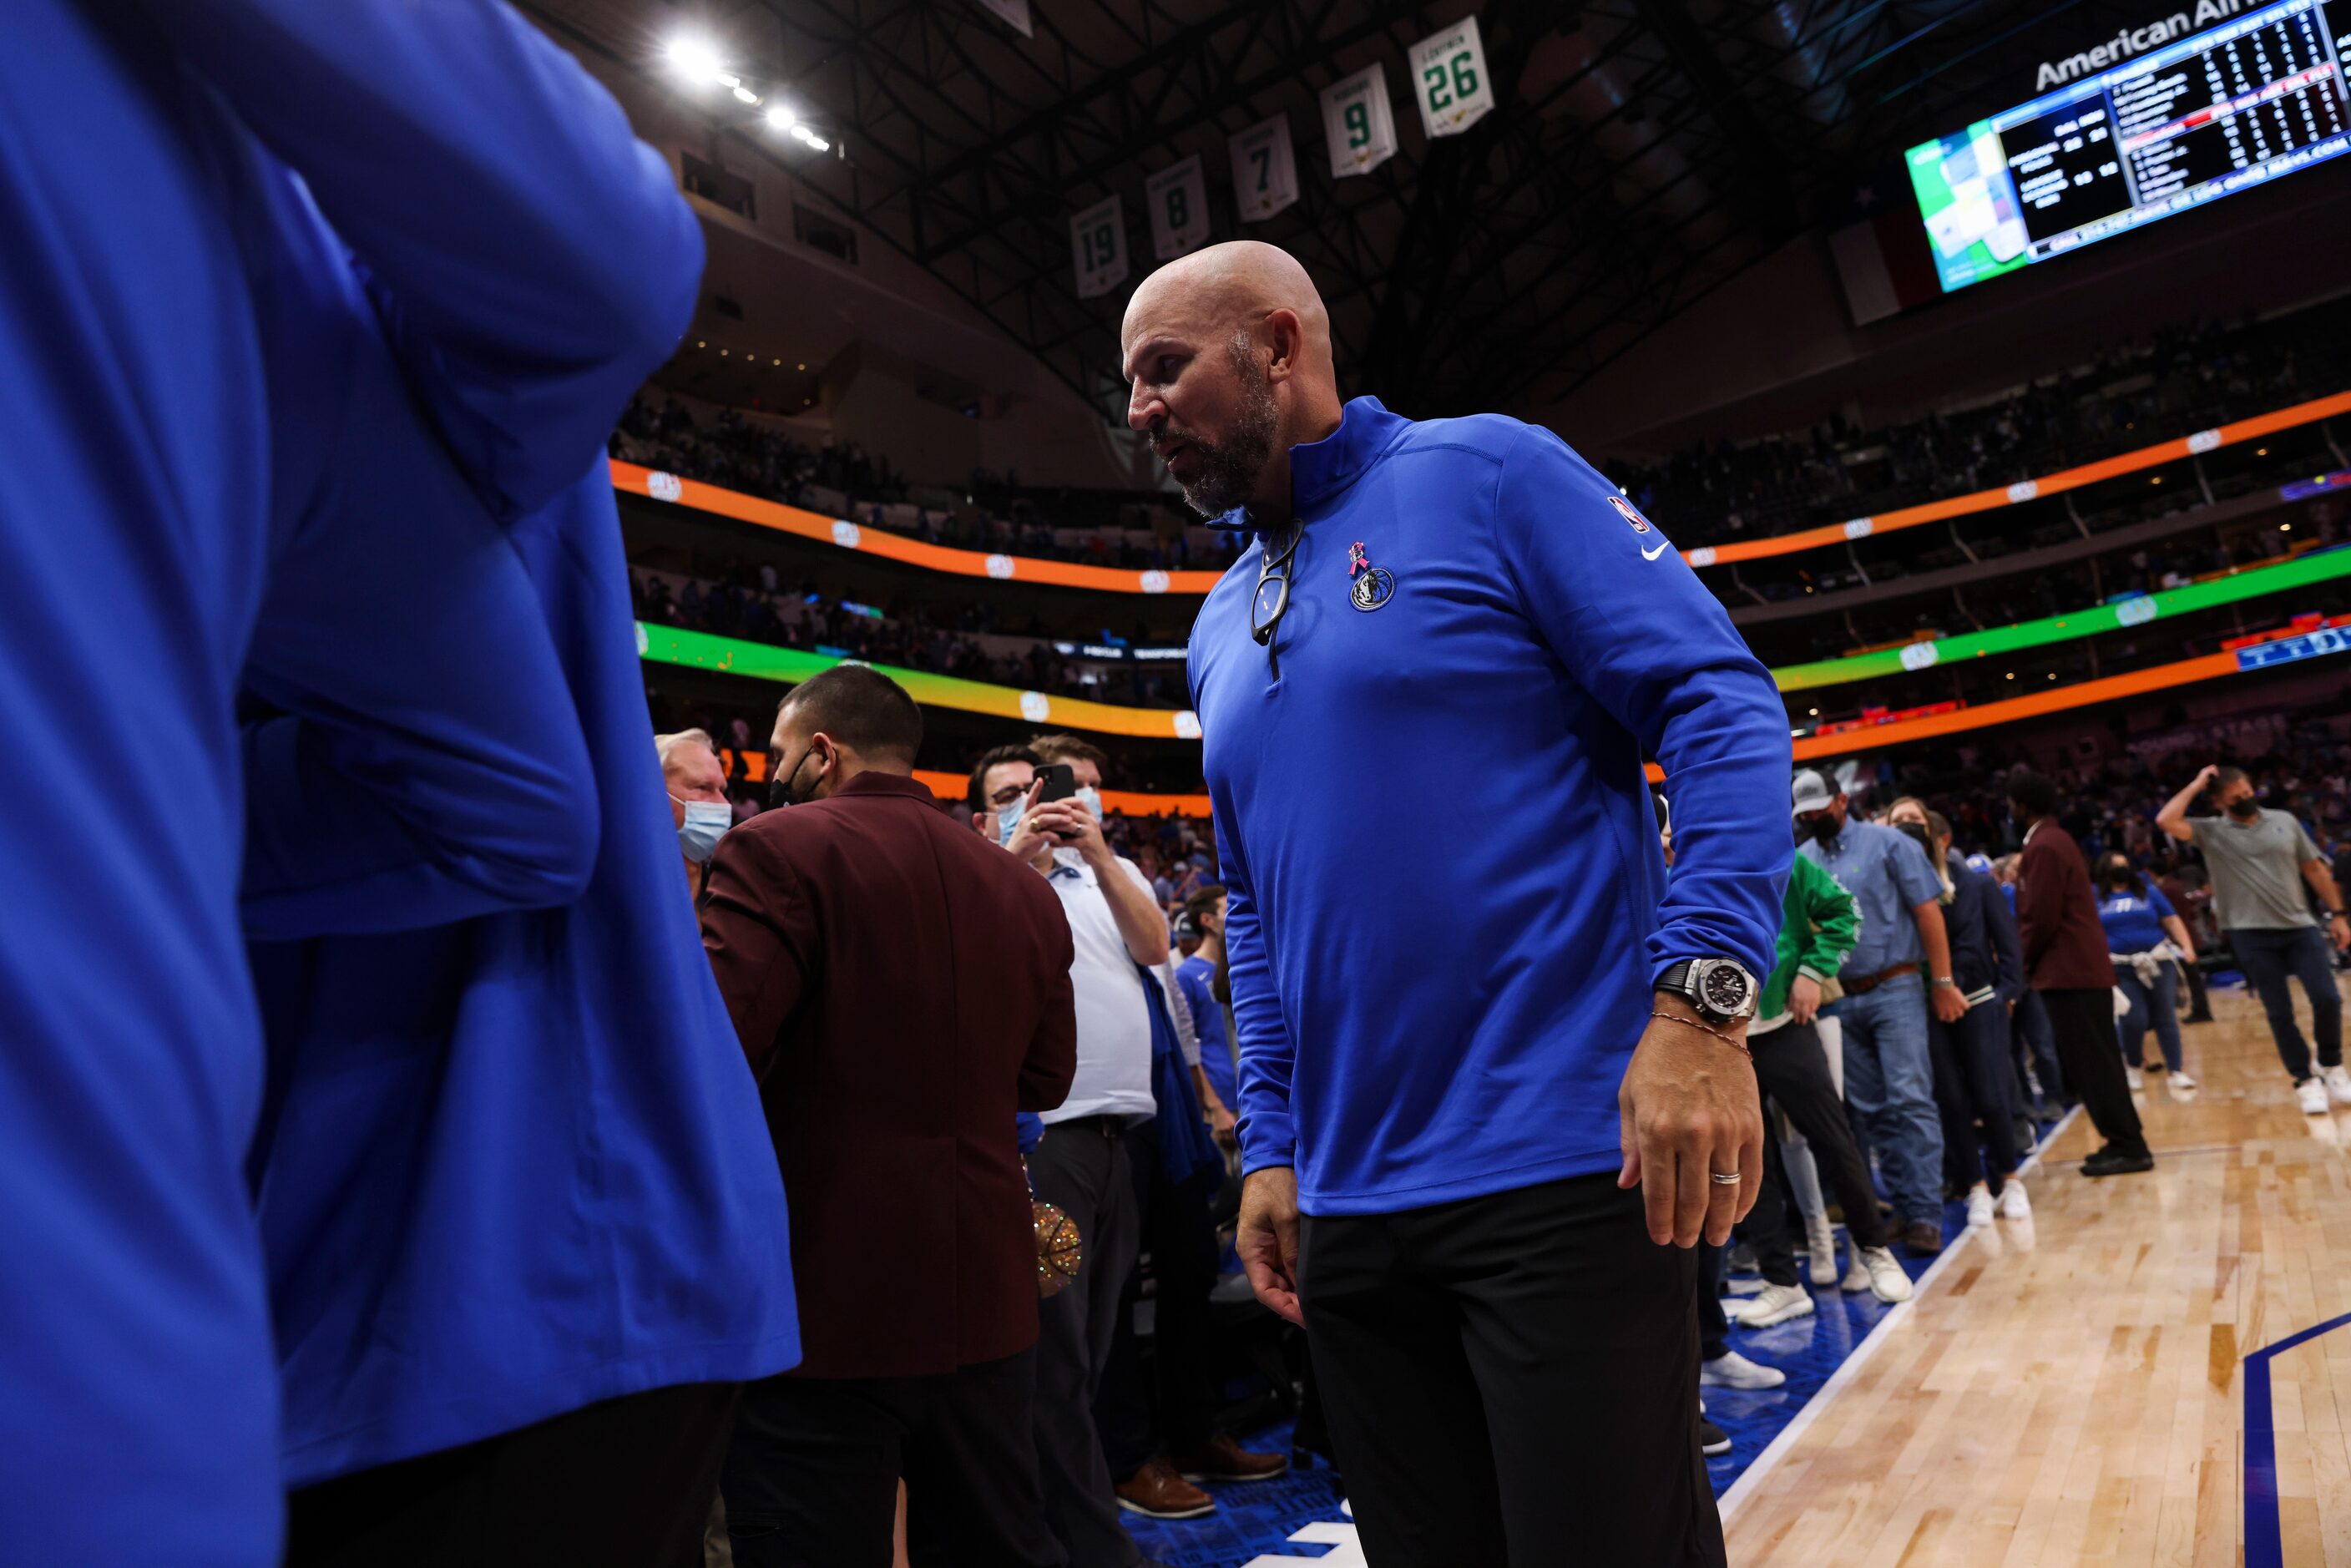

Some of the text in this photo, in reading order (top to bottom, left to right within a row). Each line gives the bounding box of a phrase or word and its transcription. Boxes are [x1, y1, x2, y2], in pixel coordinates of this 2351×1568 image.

[2035, 12, 2192, 92] American
[2194, 0, 2263, 28] Ai
[1423, 51, 1479, 113] 26
[1344, 101, 1371, 149] 9
[1251, 147, 1271, 192] 7
[1166, 186, 1187, 230] 8
[1081, 224, 1115, 272] 19
